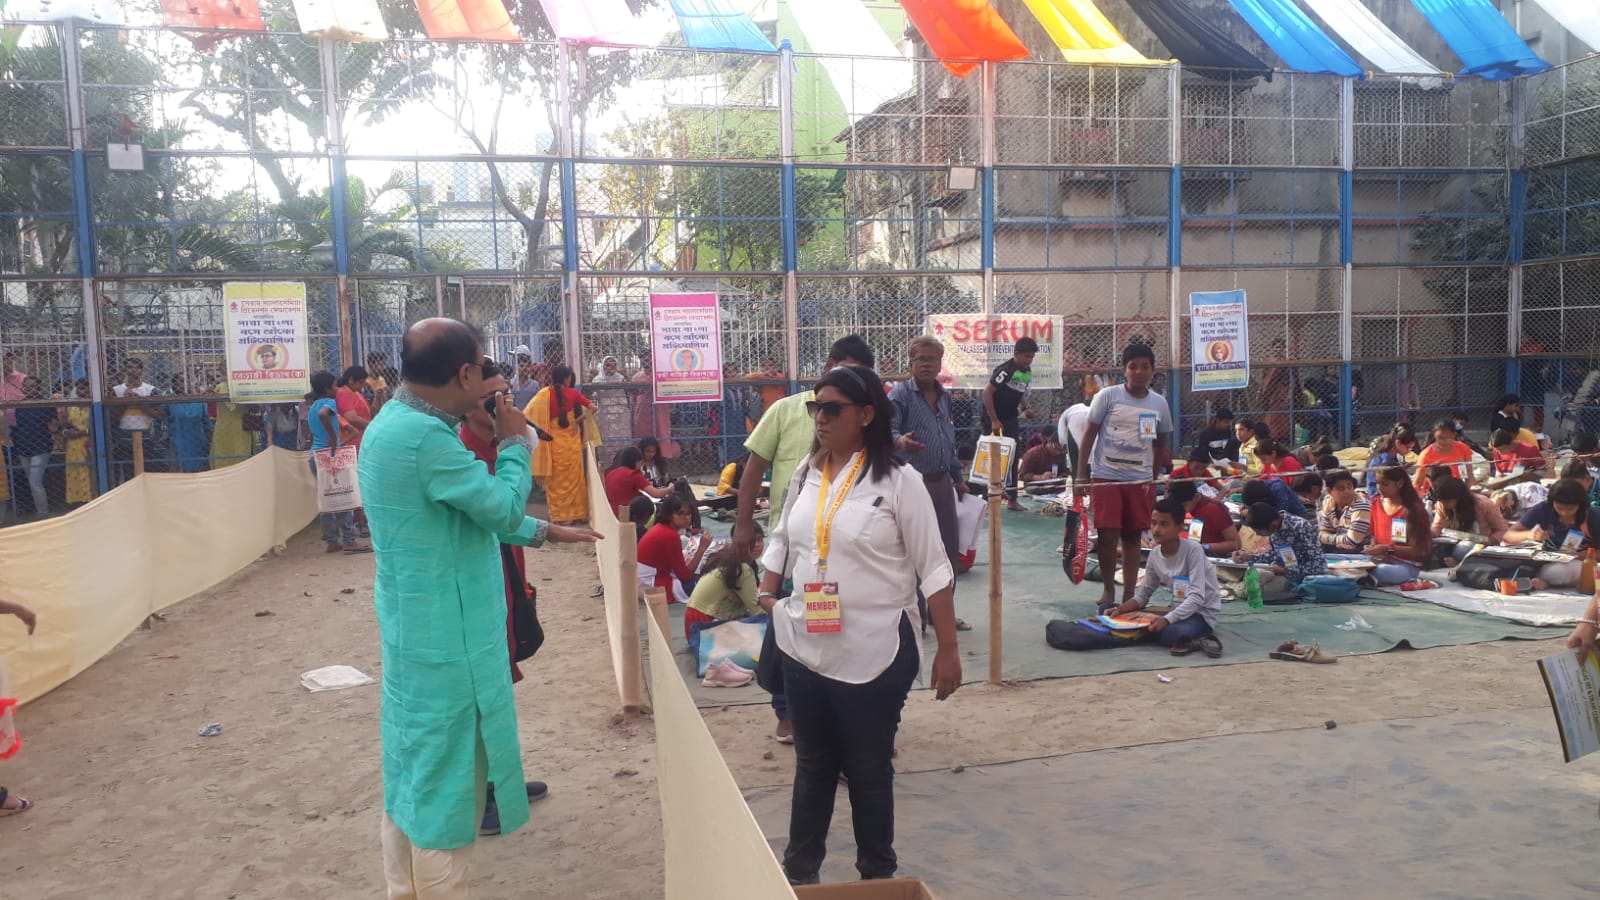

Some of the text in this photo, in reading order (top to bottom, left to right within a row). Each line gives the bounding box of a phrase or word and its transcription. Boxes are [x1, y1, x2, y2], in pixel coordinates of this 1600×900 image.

[952, 319, 1053, 343] SERUM
[996, 370, 1008, 384] 5
[806, 600, 837, 611] MEMBER
